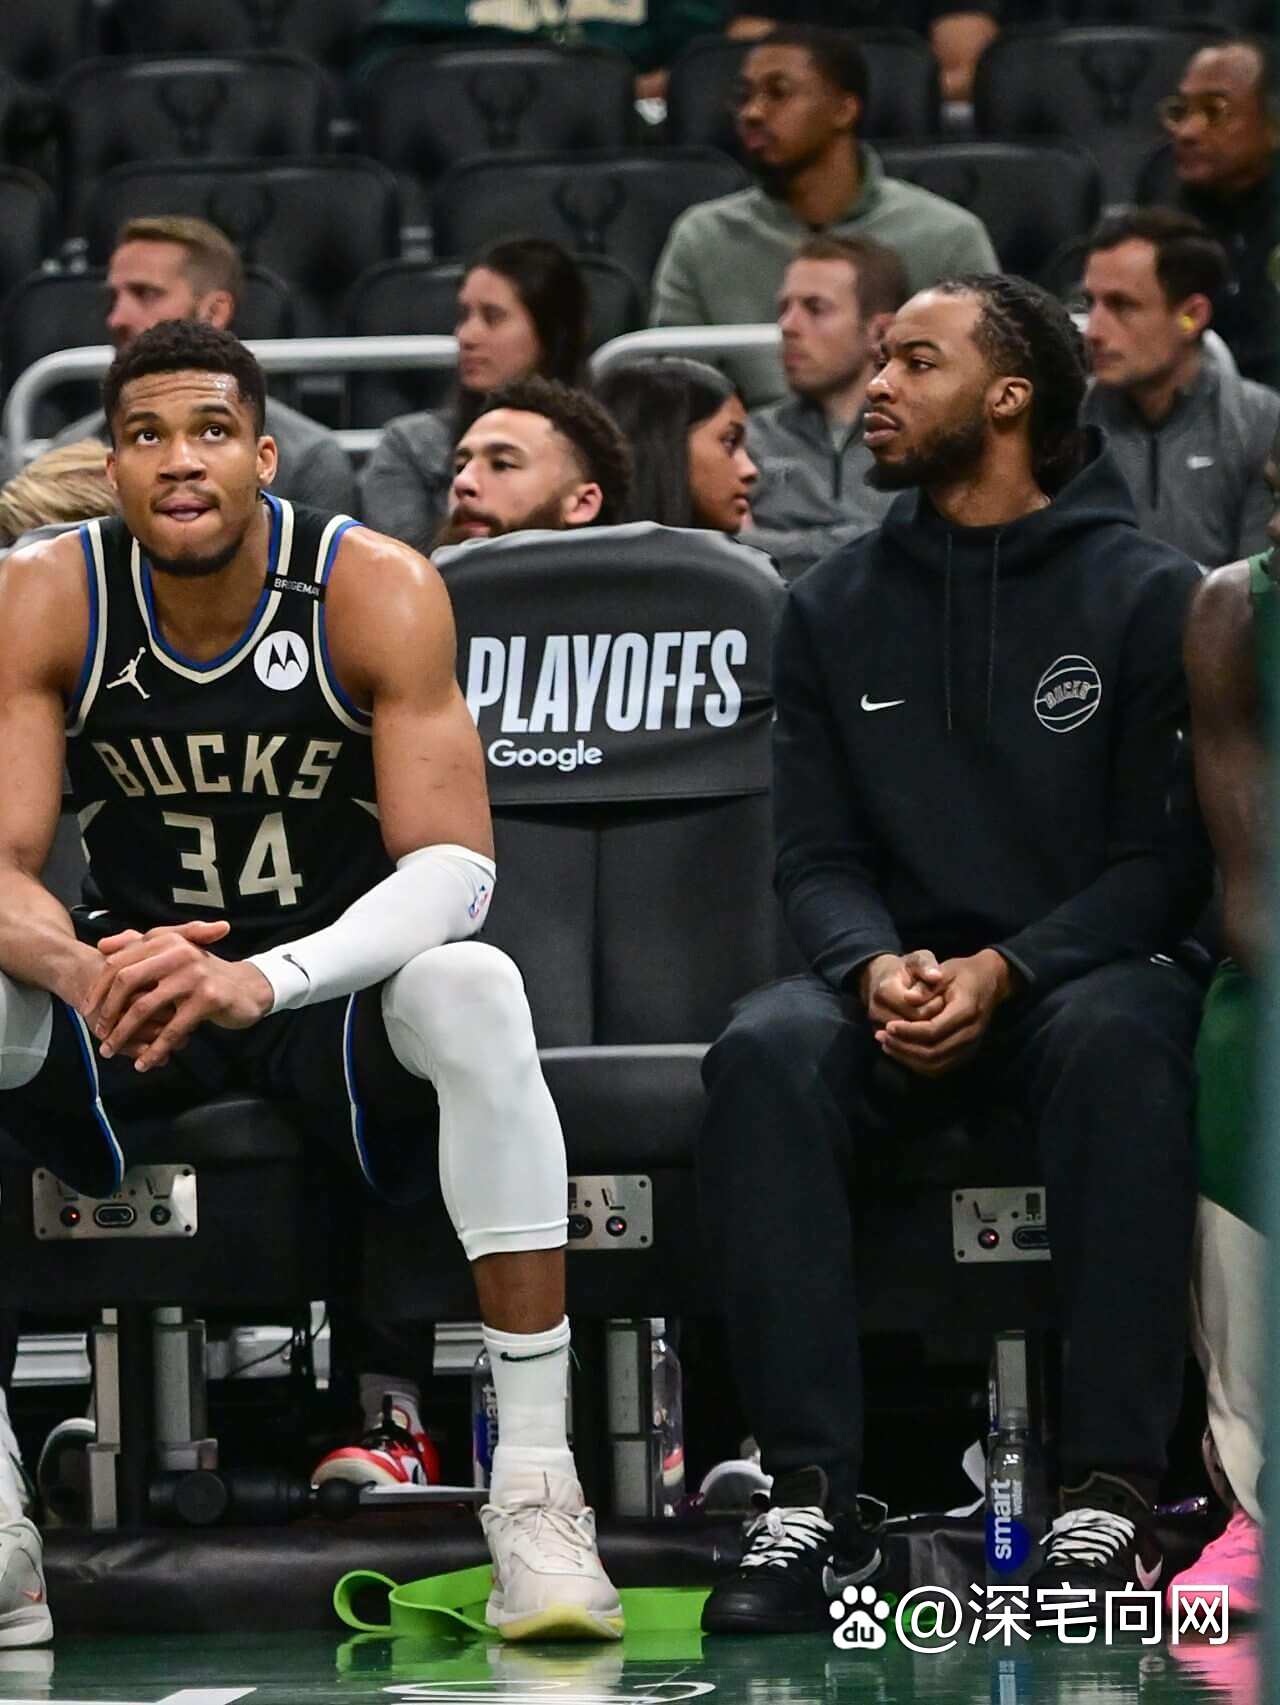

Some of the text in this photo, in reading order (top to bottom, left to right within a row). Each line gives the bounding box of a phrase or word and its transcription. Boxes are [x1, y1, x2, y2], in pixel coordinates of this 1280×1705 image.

[465, 628, 747, 732] PLAYOFFS
[92, 733, 343, 800] BUCKS
[487, 739, 603, 772] Google
[161, 811, 303, 908] 34
[990, 1478, 1012, 1560] smart
